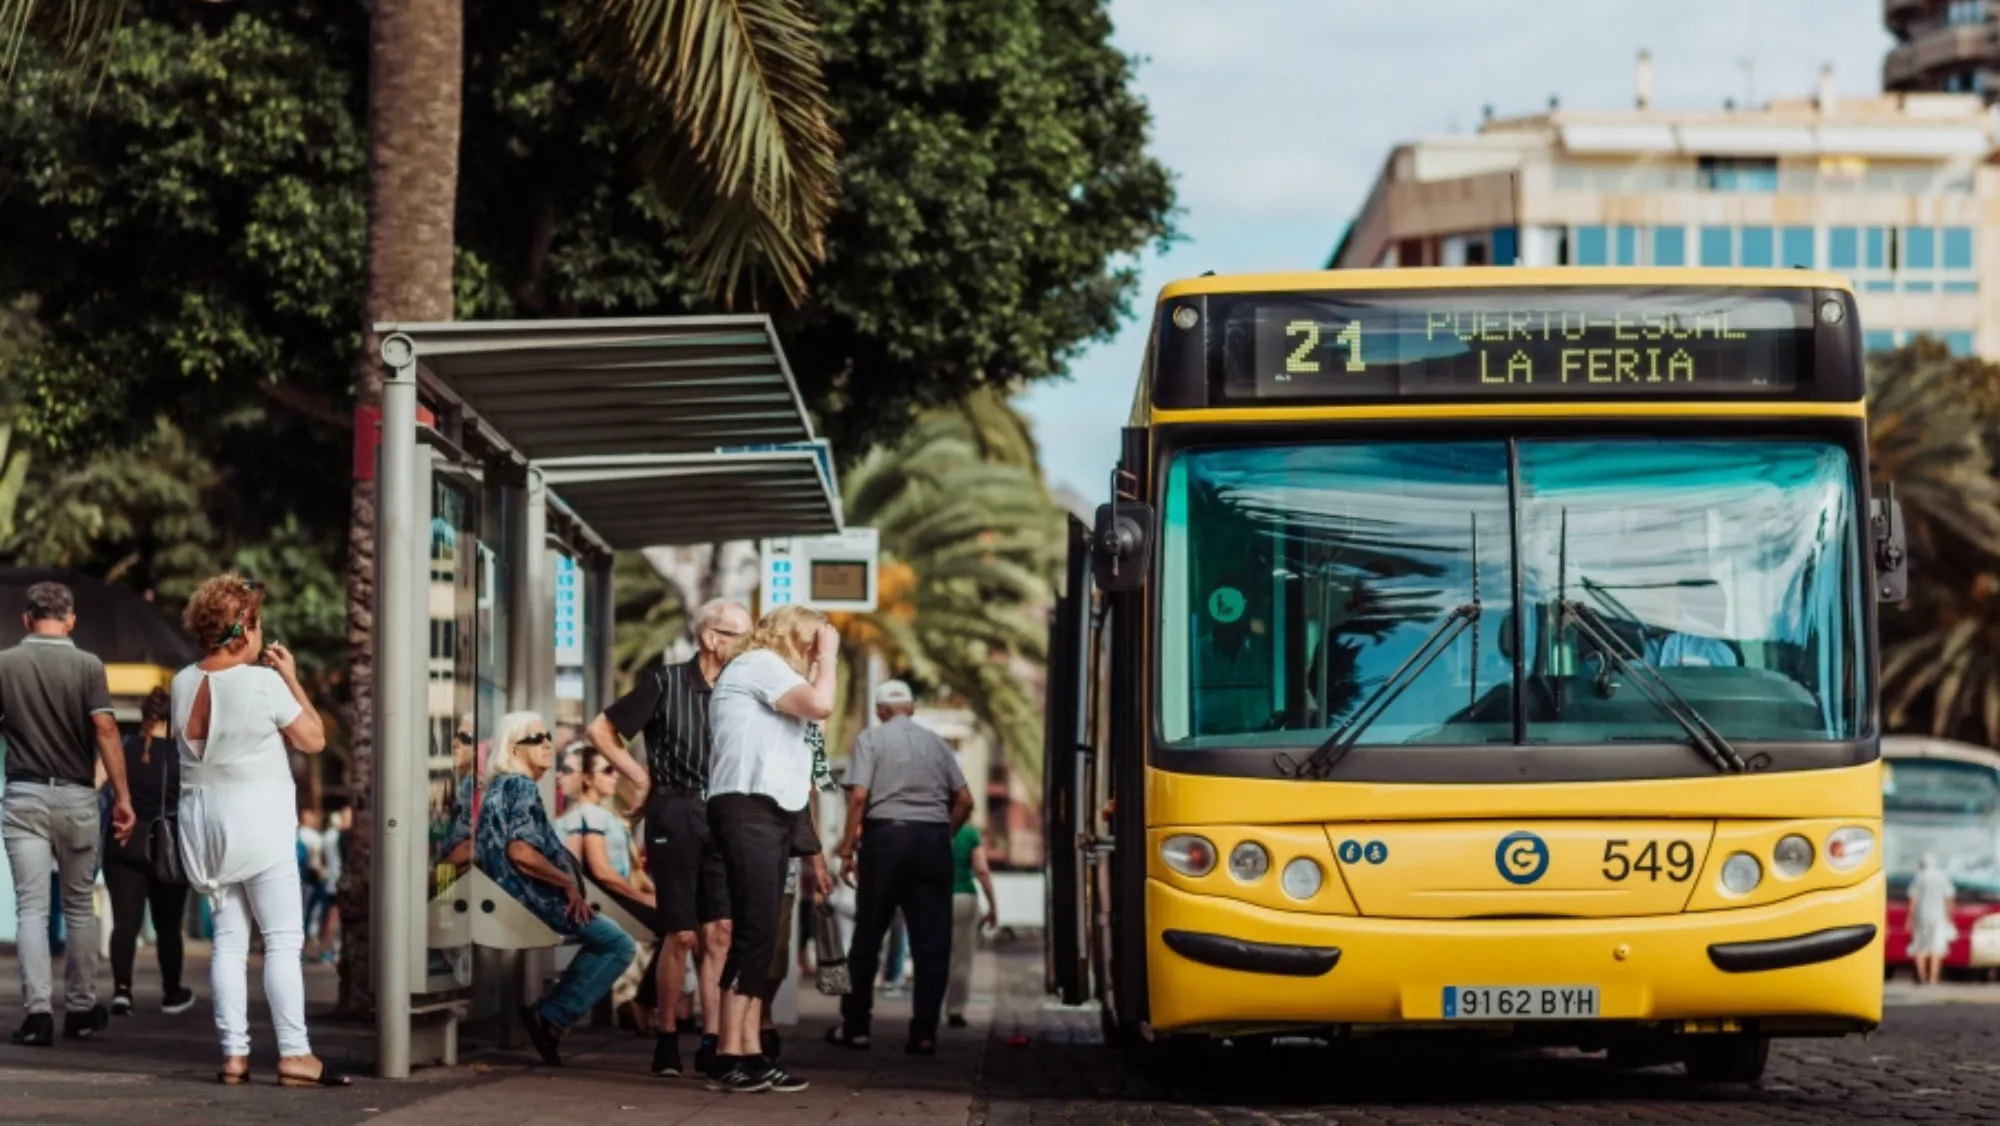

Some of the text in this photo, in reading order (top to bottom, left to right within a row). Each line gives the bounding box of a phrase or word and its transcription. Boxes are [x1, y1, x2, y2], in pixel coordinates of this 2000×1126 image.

[1286, 320, 1366, 371] 21
[1481, 349, 1694, 383] LA FERIA
[1602, 839, 1695, 882] 549
[1462, 990, 1531, 1014] 9162
[1541, 990, 1593, 1014] BYH
